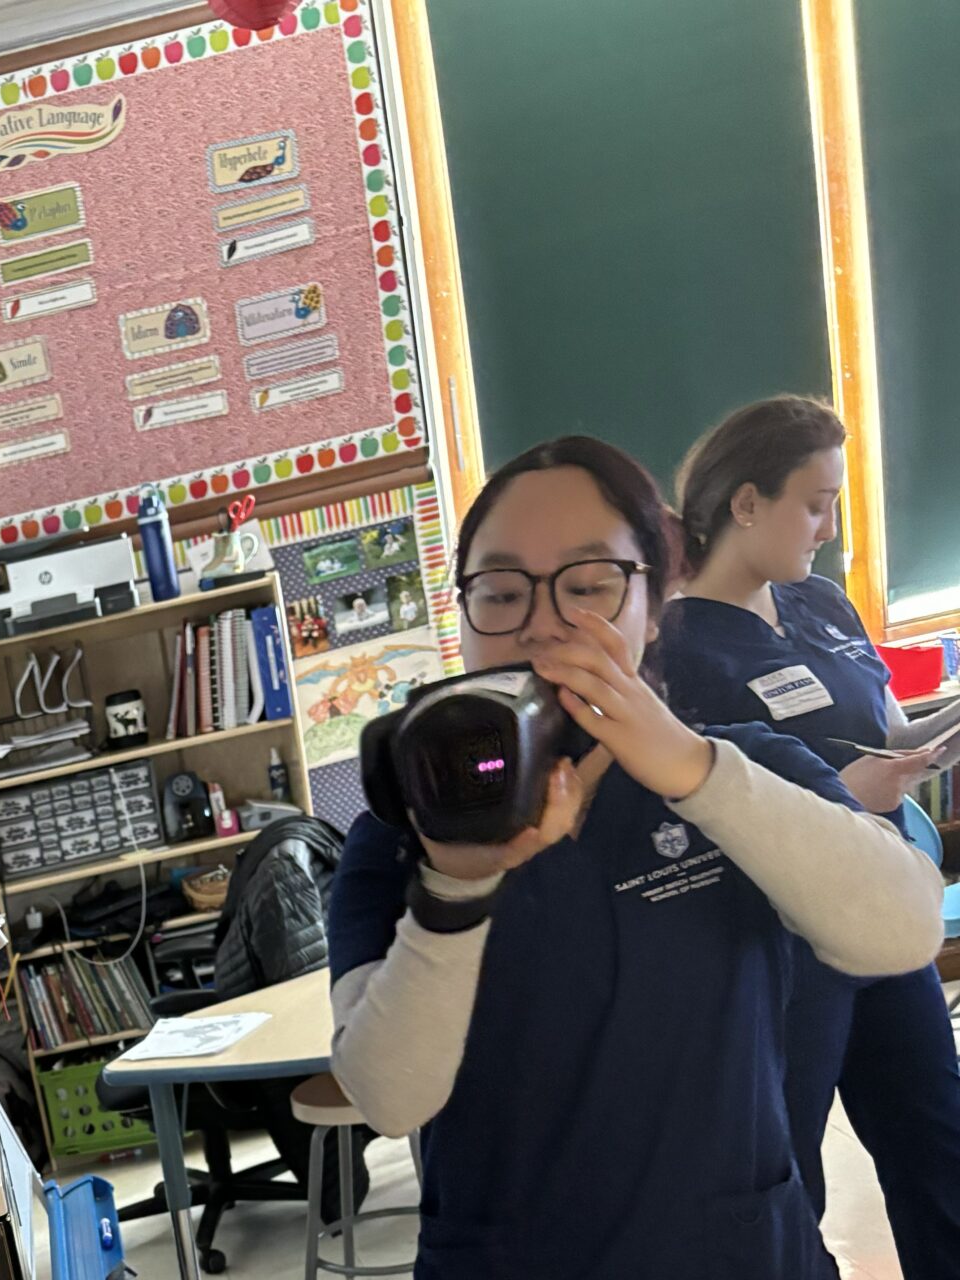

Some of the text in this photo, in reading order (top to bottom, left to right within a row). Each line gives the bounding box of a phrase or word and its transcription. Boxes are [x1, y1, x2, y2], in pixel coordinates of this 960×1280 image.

[38, 107, 104, 128] Language
[614, 848, 721, 892] SAINT LOUIS UNIVER
